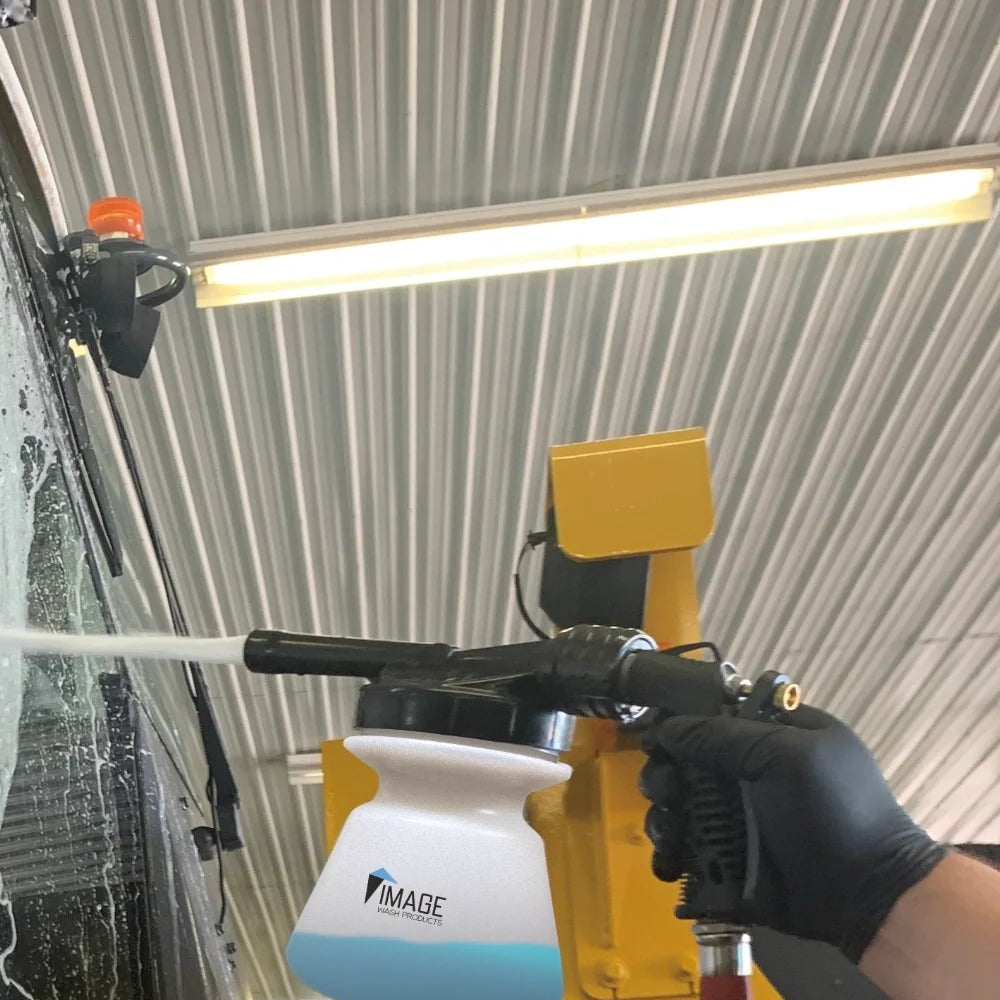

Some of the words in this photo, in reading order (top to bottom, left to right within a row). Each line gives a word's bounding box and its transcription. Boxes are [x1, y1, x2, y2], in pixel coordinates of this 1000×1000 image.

[379, 884, 447, 918] IMAGE
[377, 905, 400, 918] WASH
[401, 911, 443, 927] PRODUCTS
